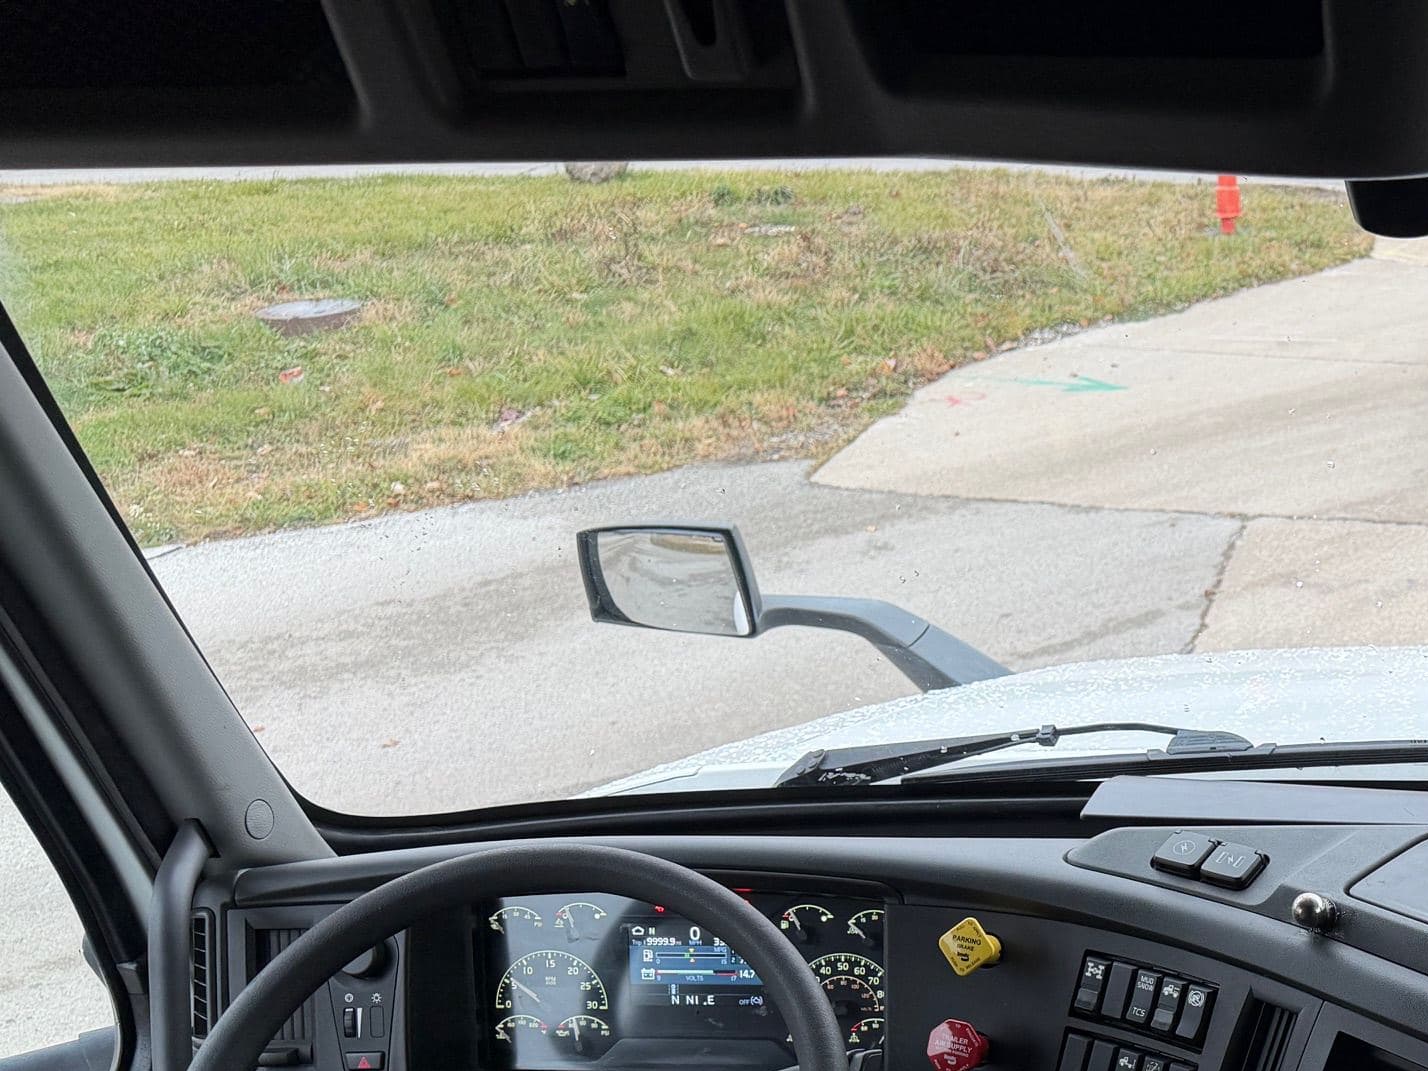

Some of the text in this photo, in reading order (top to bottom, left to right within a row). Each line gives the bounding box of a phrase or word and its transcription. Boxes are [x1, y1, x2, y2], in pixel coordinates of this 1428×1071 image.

[689, 926, 701, 940] 0
[953, 935, 982, 946] PARKING
[545, 959, 556, 968] 15
[837, 962, 849, 971] 50
[523, 967, 533, 975] 10
[567, 967, 579, 976] 20
[739, 969, 756, 979] 14.7
[820, 966, 832, 975] 40
[854, 967, 866, 976] 60
[868, 976, 880, 985] 70
[1140, 975, 1154, 985] MUD
[511, 982, 518, 990] 5
[580, 982, 592, 991] 25
[1138, 982, 1154, 991] SNOW
[505, 1000, 512, 1009] 0
[671, 995, 680, 1005] N
[586, 1000, 598, 1010] 30
[1132, 1006, 1146, 1017] TCS
